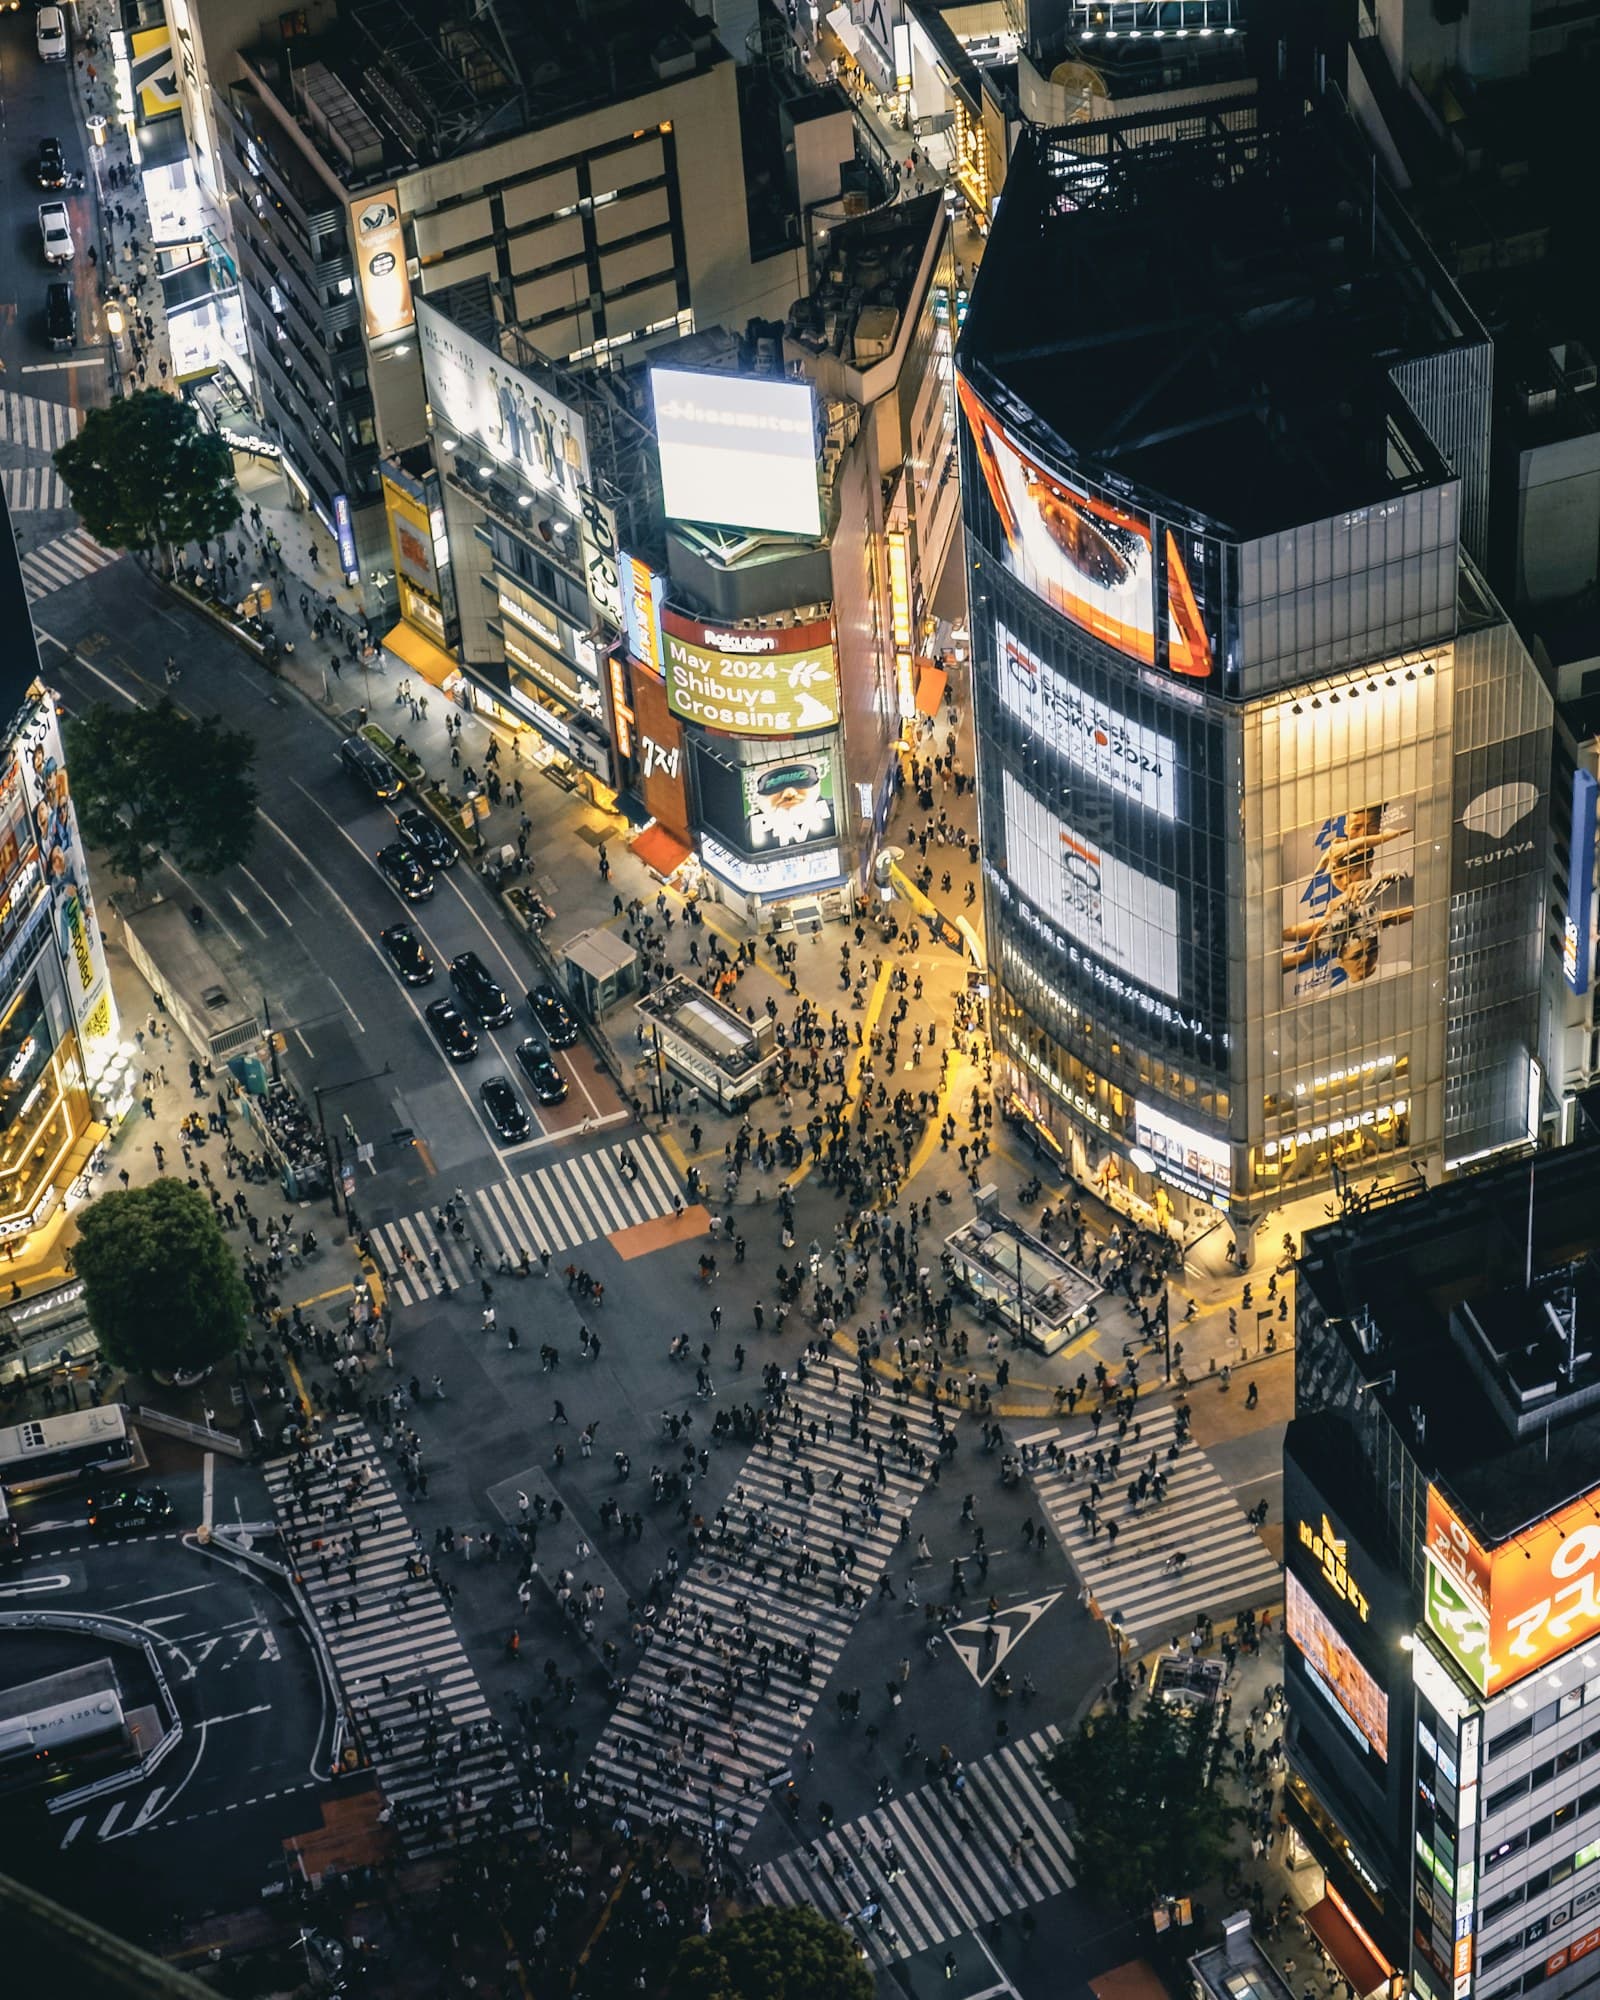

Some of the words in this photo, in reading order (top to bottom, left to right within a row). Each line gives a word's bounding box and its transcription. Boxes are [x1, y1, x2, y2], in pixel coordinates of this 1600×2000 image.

[669, 642, 712, 674] May
[720, 659, 777, 679] 2024
[704, 630, 775, 651] Rakuten
[673, 666, 776, 707] Shibuya
[674, 689, 791, 730] Crossing
[1114, 741, 1163, 778] 2024
[1465, 840, 1535, 870] TSUTAYA
[67, 897, 94, 992] Unspoiled
[1011, 1032, 1110, 1129] STARBUCKS
[1264, 1100, 1407, 1157] STARBUCKS
[1508, 1572, 1600, 1658] アコ
